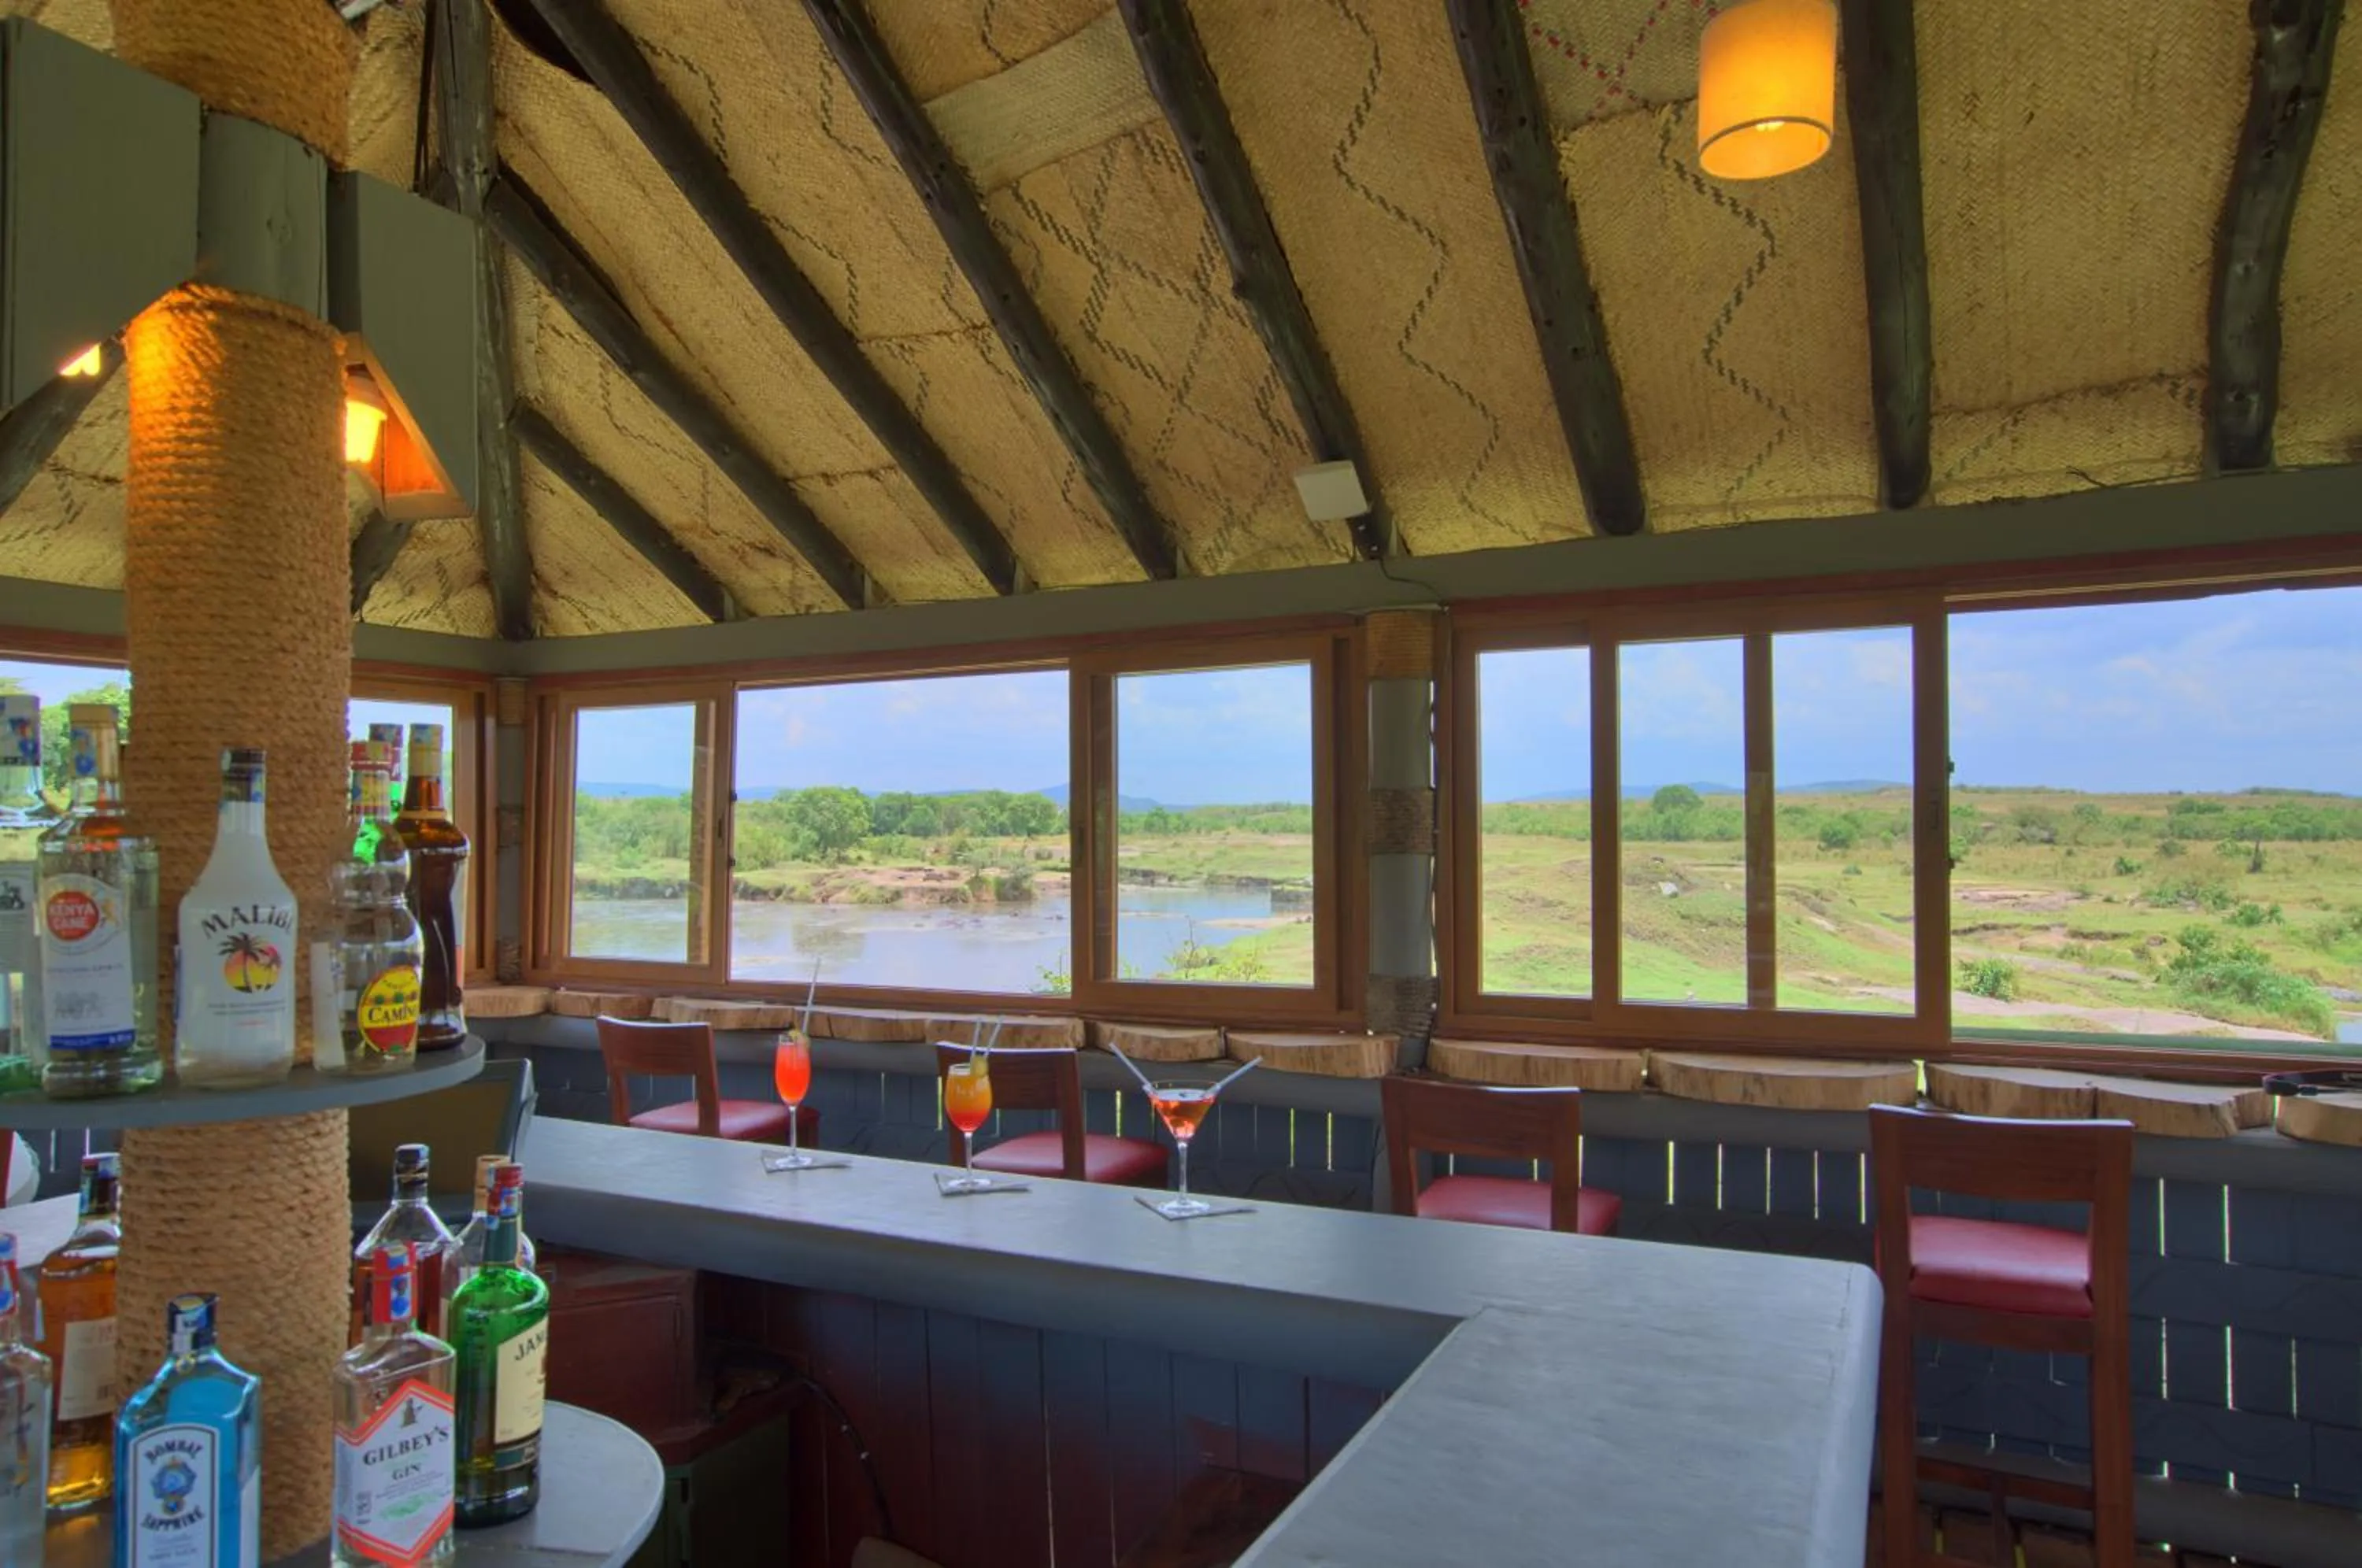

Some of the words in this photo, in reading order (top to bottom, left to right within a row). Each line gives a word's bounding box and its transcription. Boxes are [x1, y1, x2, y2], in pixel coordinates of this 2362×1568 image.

[49, 903, 94, 917] KENYA
[52, 916, 88, 930] CANE
[145, 1439, 203, 1464] BOMBAY
[363, 1425, 449, 1466] GILBEY'S
[392, 1463, 422, 1481] GIN
